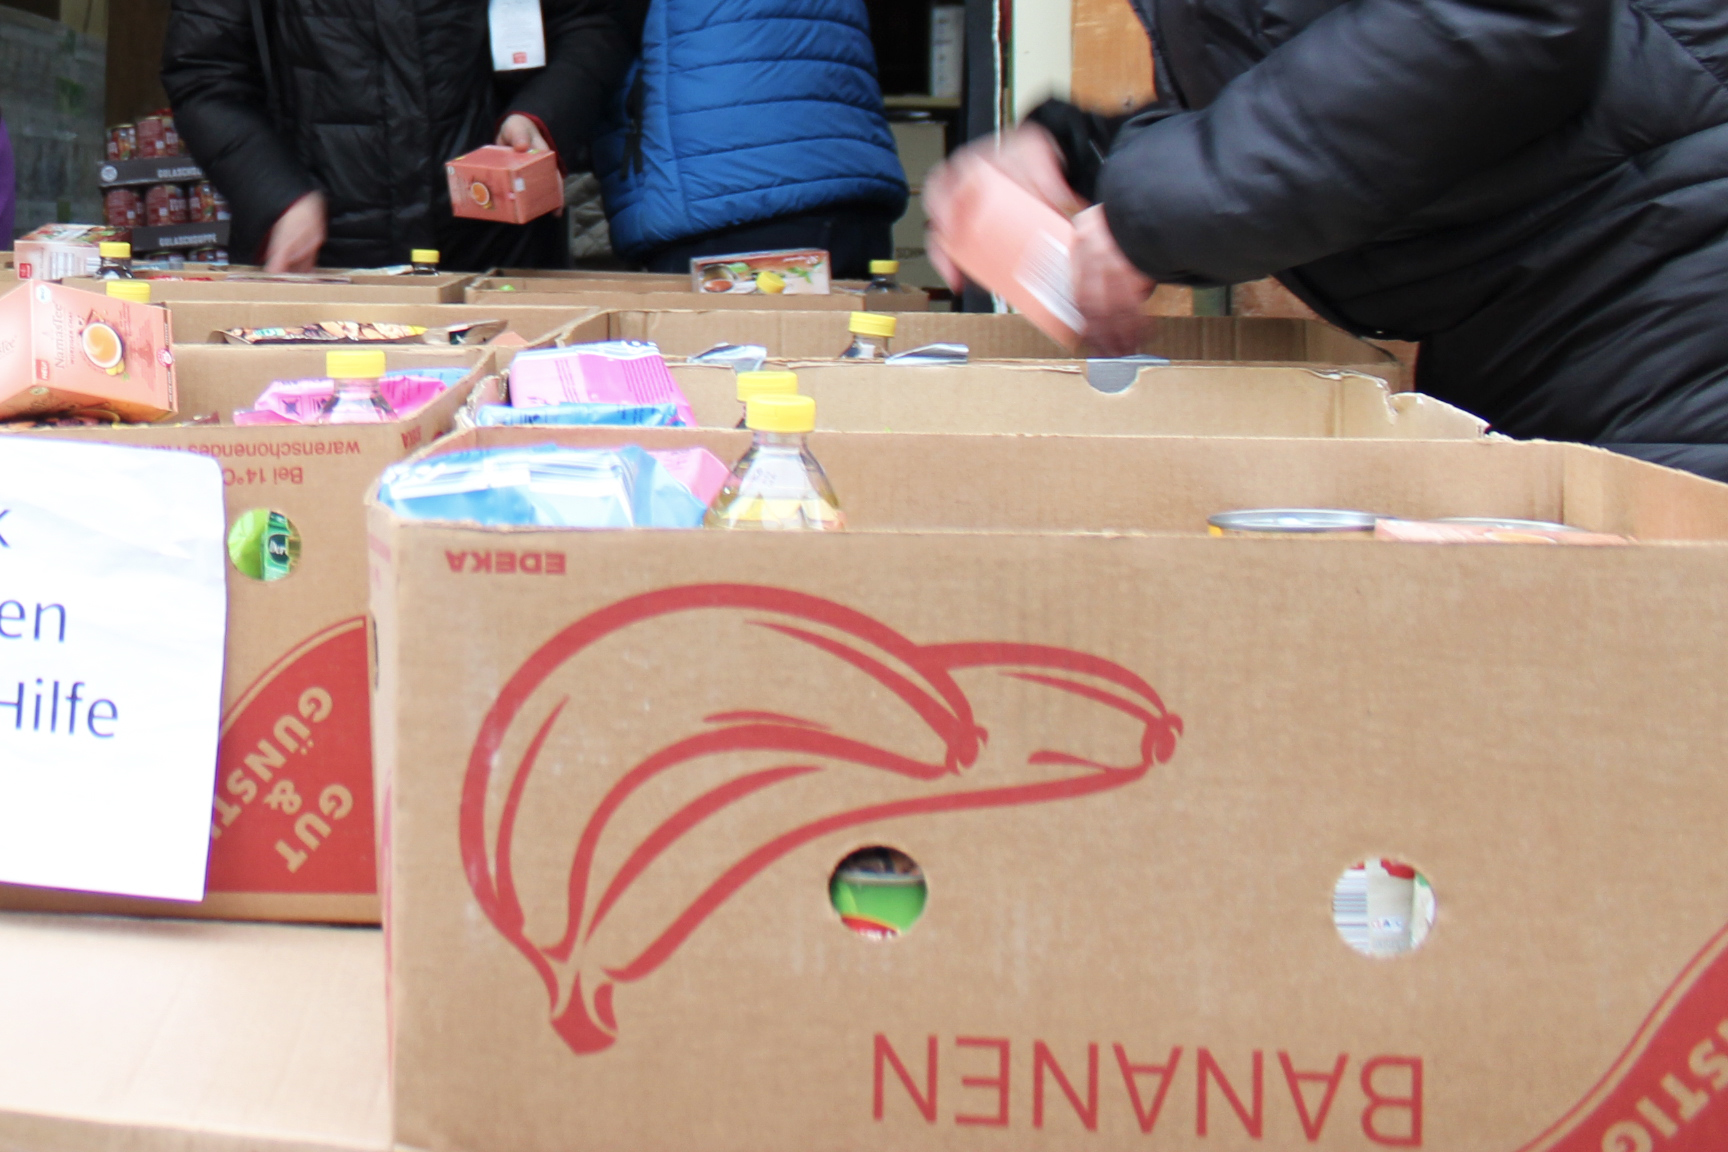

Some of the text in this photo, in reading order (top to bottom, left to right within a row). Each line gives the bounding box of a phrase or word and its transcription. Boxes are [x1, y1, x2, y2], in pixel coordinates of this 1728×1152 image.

[187, 438, 361, 460] warenschonendes
[273, 466, 304, 486] Bei
[445, 548, 567, 576] EDEKA
[263, 779, 354, 873] GUT &
[873, 1033, 1424, 1147] BANANEN
[1601, 1020, 1728, 1152] STIG
